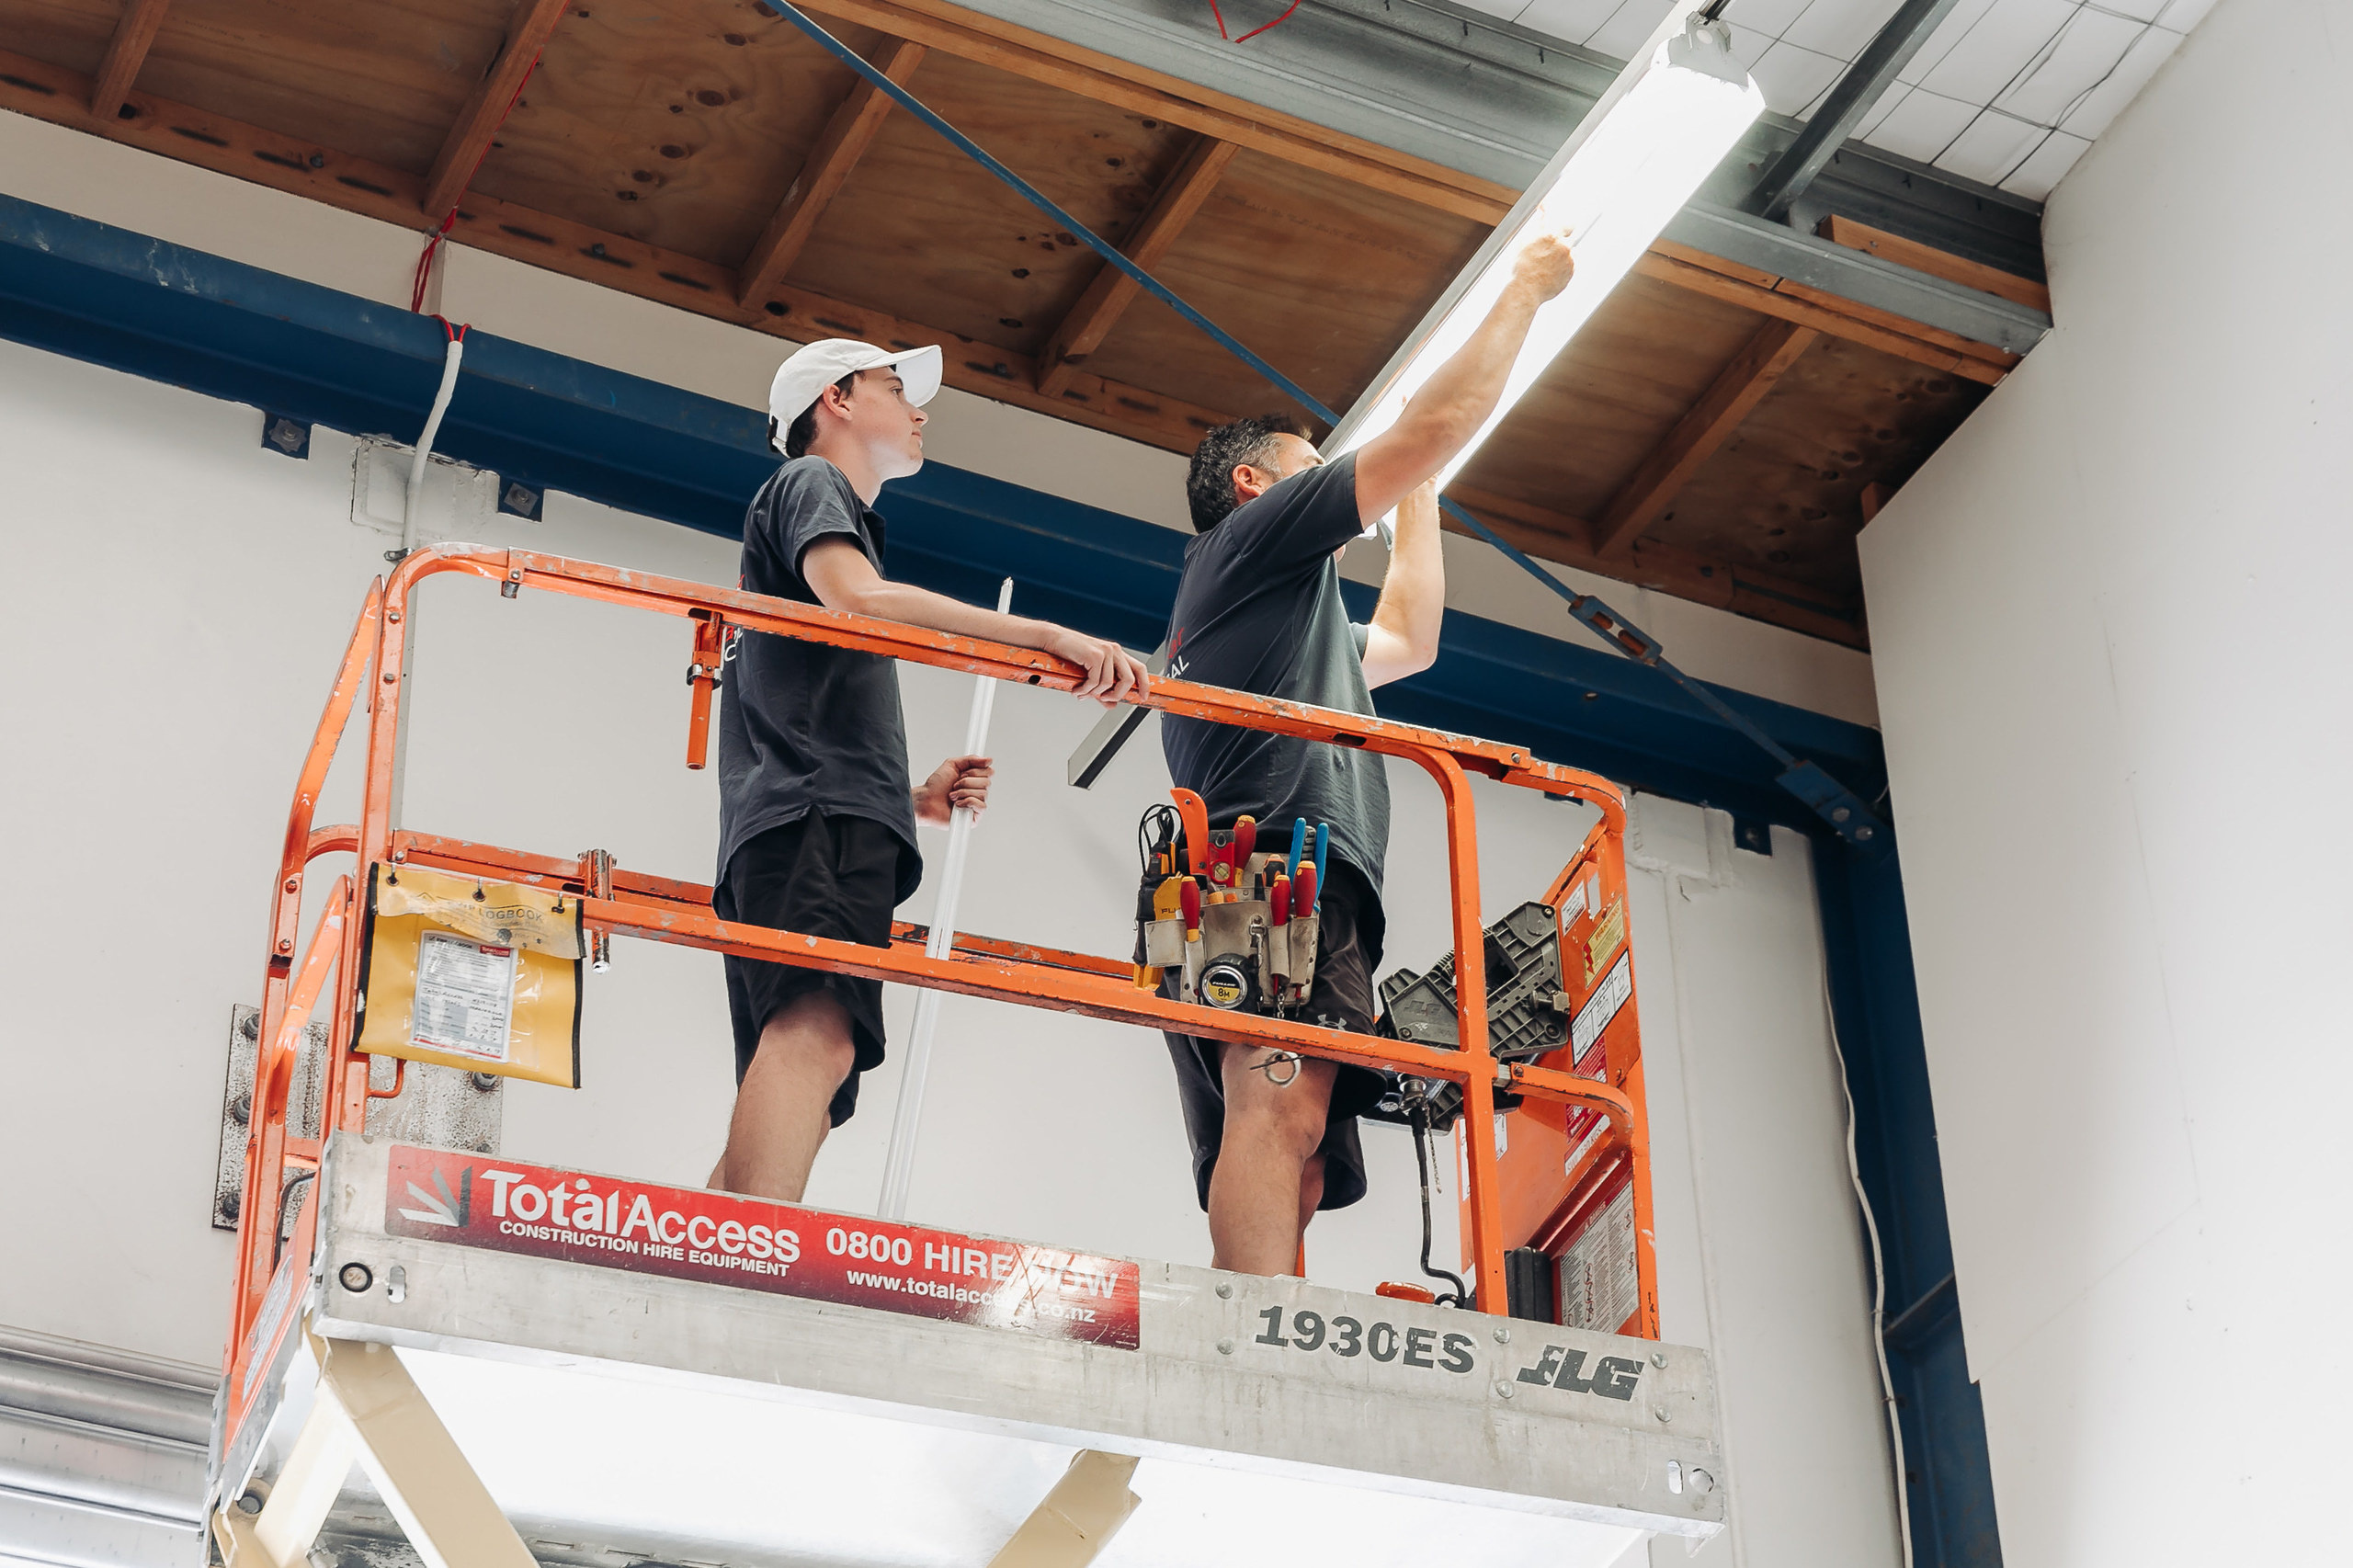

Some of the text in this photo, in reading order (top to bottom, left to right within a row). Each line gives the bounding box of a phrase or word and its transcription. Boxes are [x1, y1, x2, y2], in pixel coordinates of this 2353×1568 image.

[479, 908, 542, 924] LOGBOOK
[499, 1221, 790, 1278] CONSTRUCTION HIRE EQUIPMENT
[826, 1227, 913, 1267] 0800
[924, 1242, 1013, 1281] HIRE
[847, 1269, 1096, 1324] www.totalaccco.nz
[1255, 1305, 1645, 1402] 1930ES JLG
